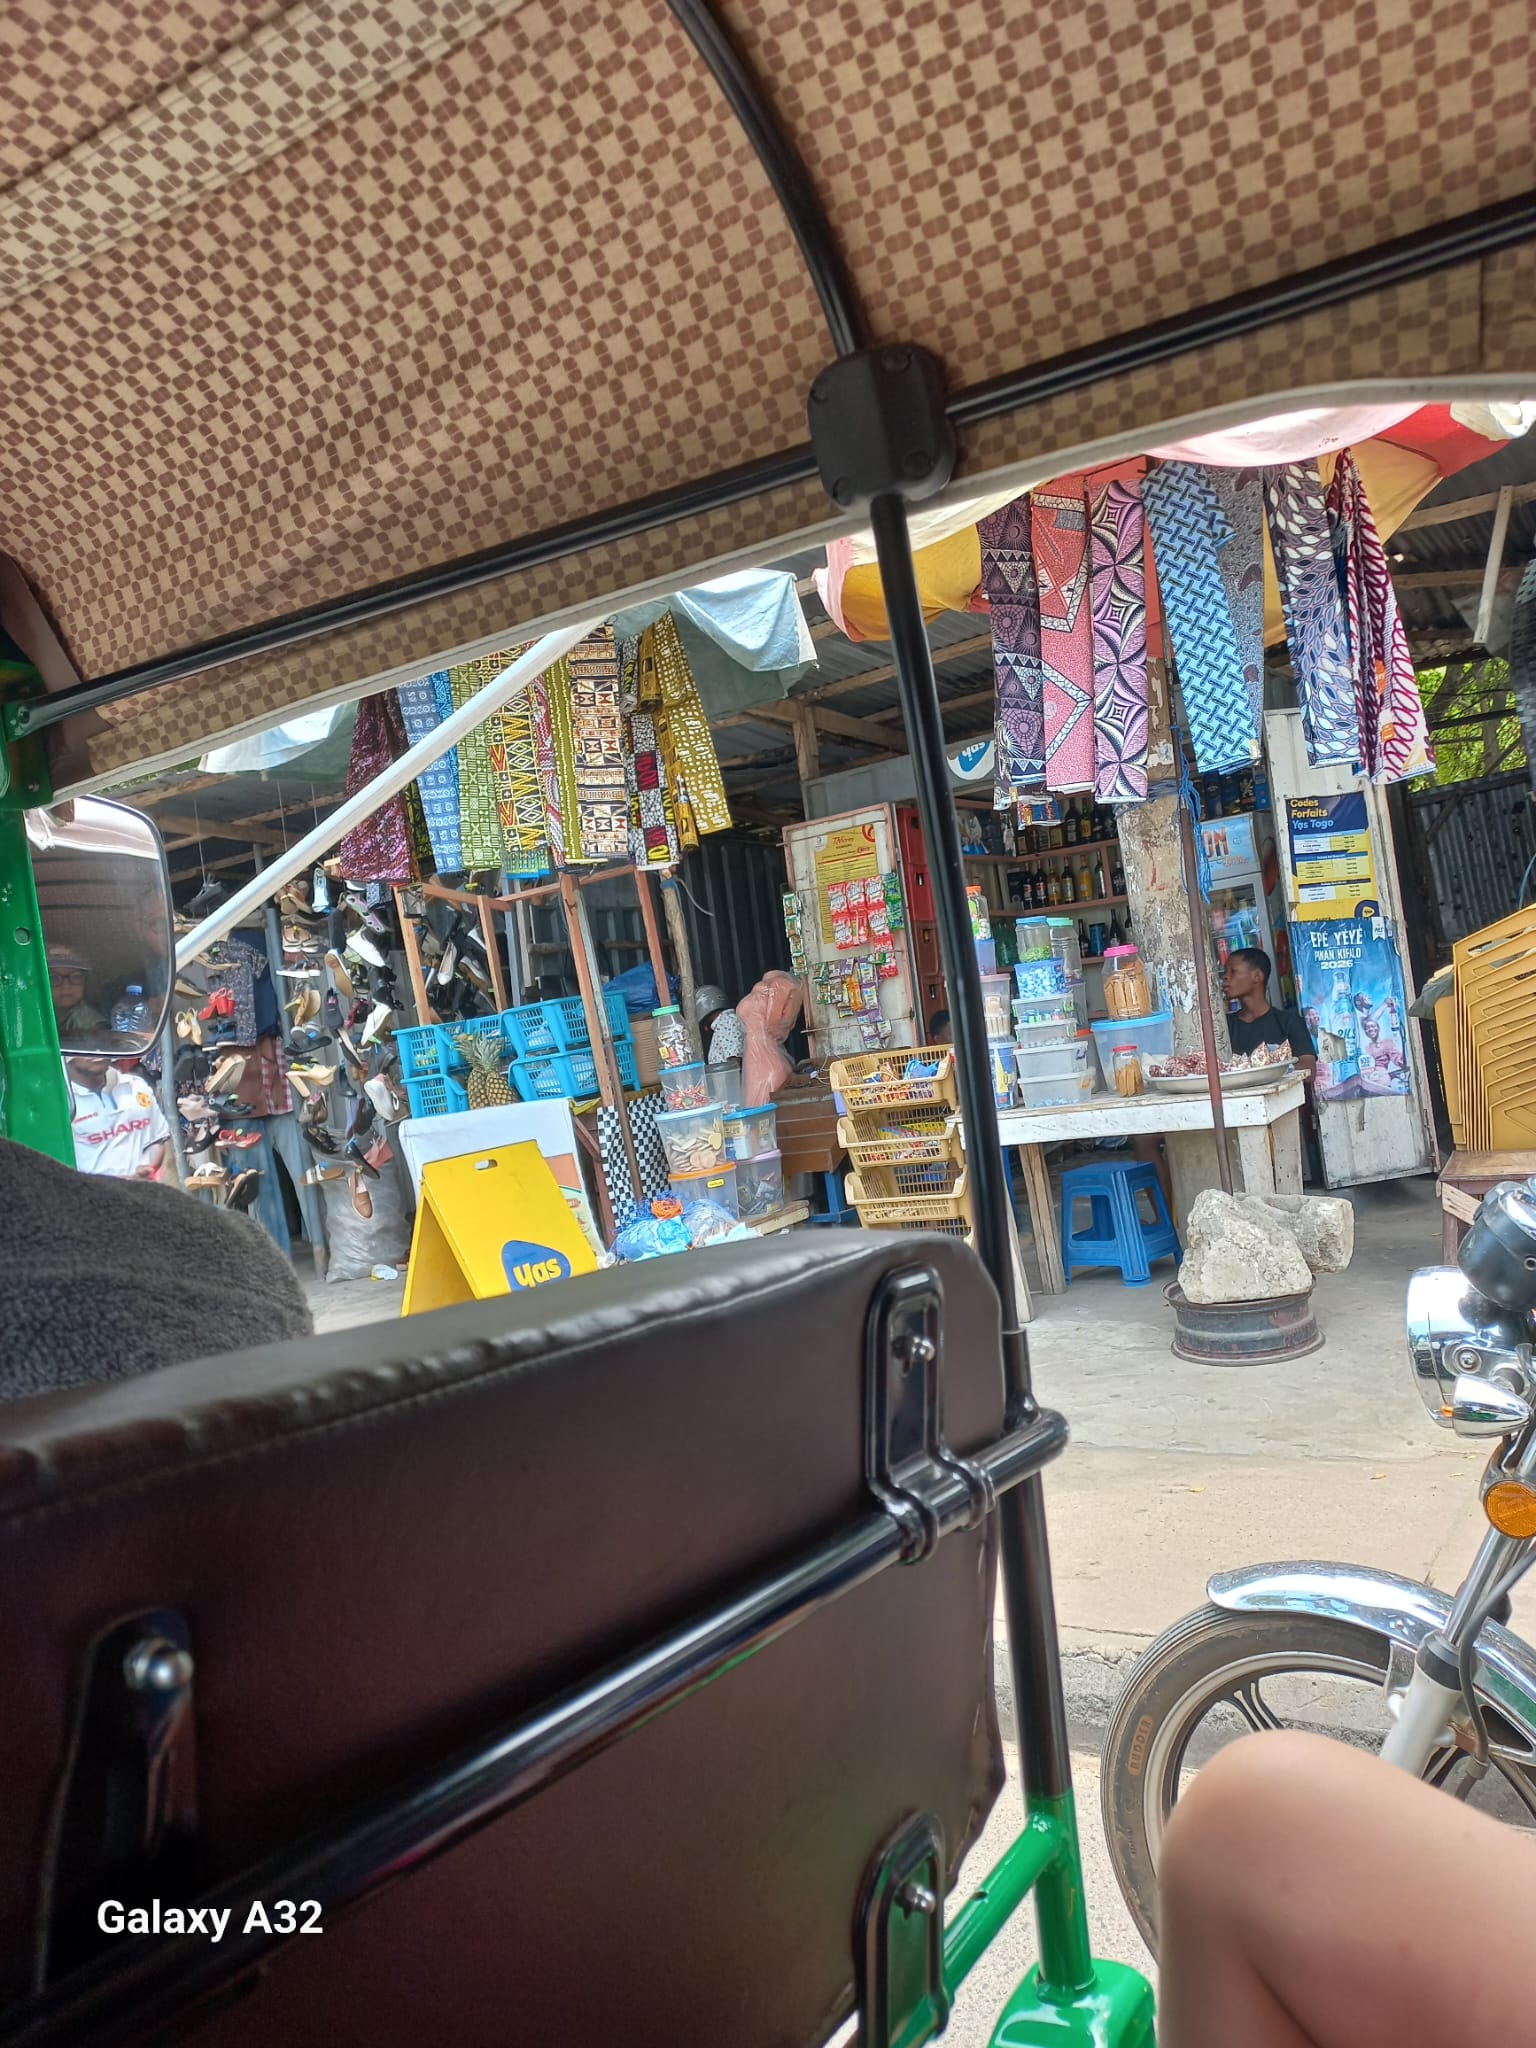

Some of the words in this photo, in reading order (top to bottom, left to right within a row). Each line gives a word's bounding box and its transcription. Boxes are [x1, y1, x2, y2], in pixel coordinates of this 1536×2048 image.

[1290, 799, 1319, 808] Codes
[1291, 808, 1329, 819] Forfaits
[1310, 819, 1334, 830] Togo
[1321, 960, 1354, 970] 2026
[87, 1118, 151, 1144] SHARP
[512, 1258, 562, 1288] yas
